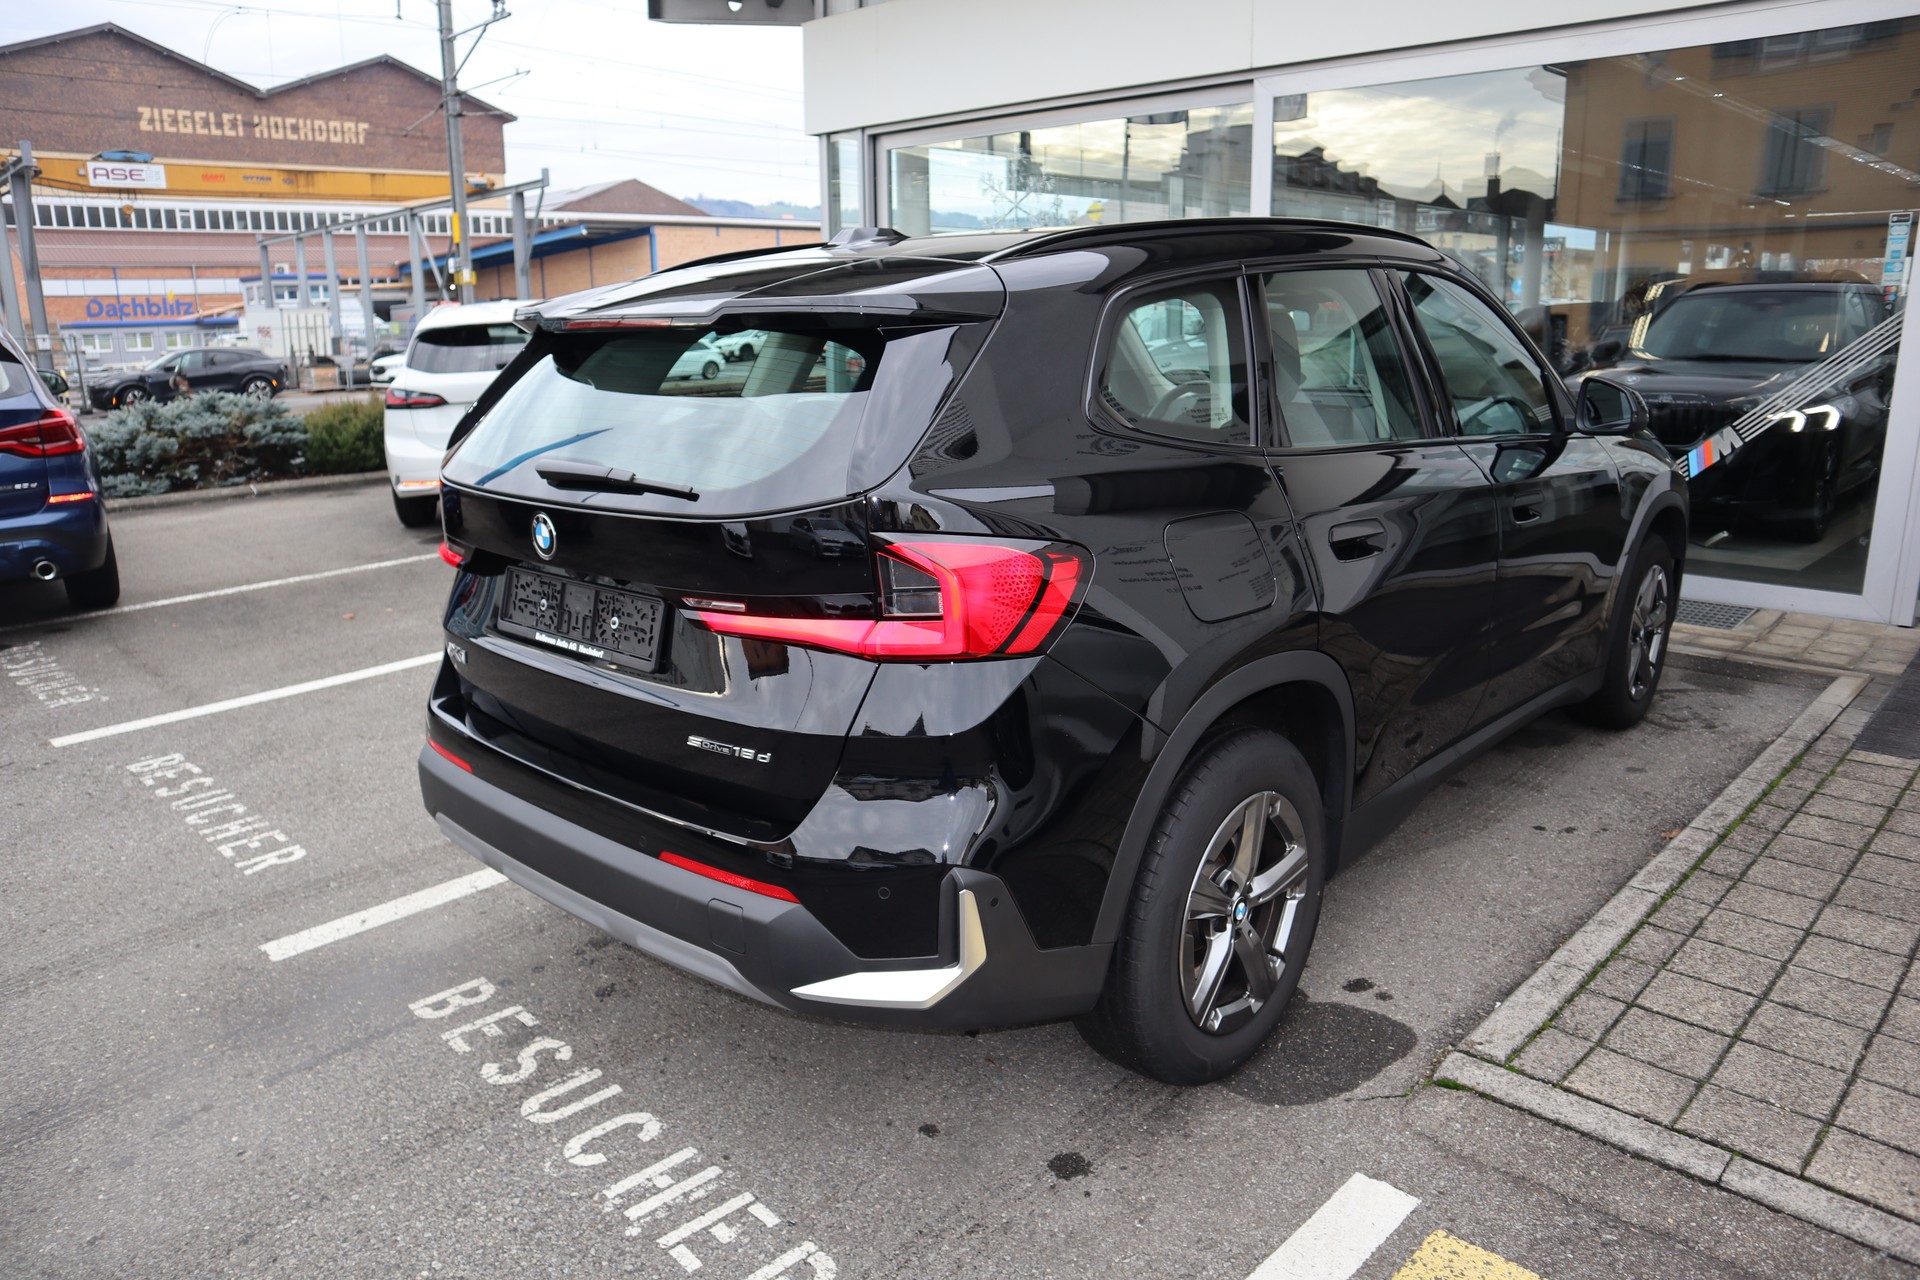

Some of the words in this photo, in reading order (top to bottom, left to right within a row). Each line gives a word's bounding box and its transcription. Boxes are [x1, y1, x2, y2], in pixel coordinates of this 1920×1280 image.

[137, 106, 244, 137] ZIEGELEI
[253, 114, 370, 145] HOCHDORF
[92, 167, 146, 182] ASE
[86, 295, 194, 318] Dachblitz
[555, 638, 569, 649] Auto
[568, 641, 578, 651] AG
[578, 644, 604, 659] Hochdorf
[126, 753, 307, 875] BESUCHER
